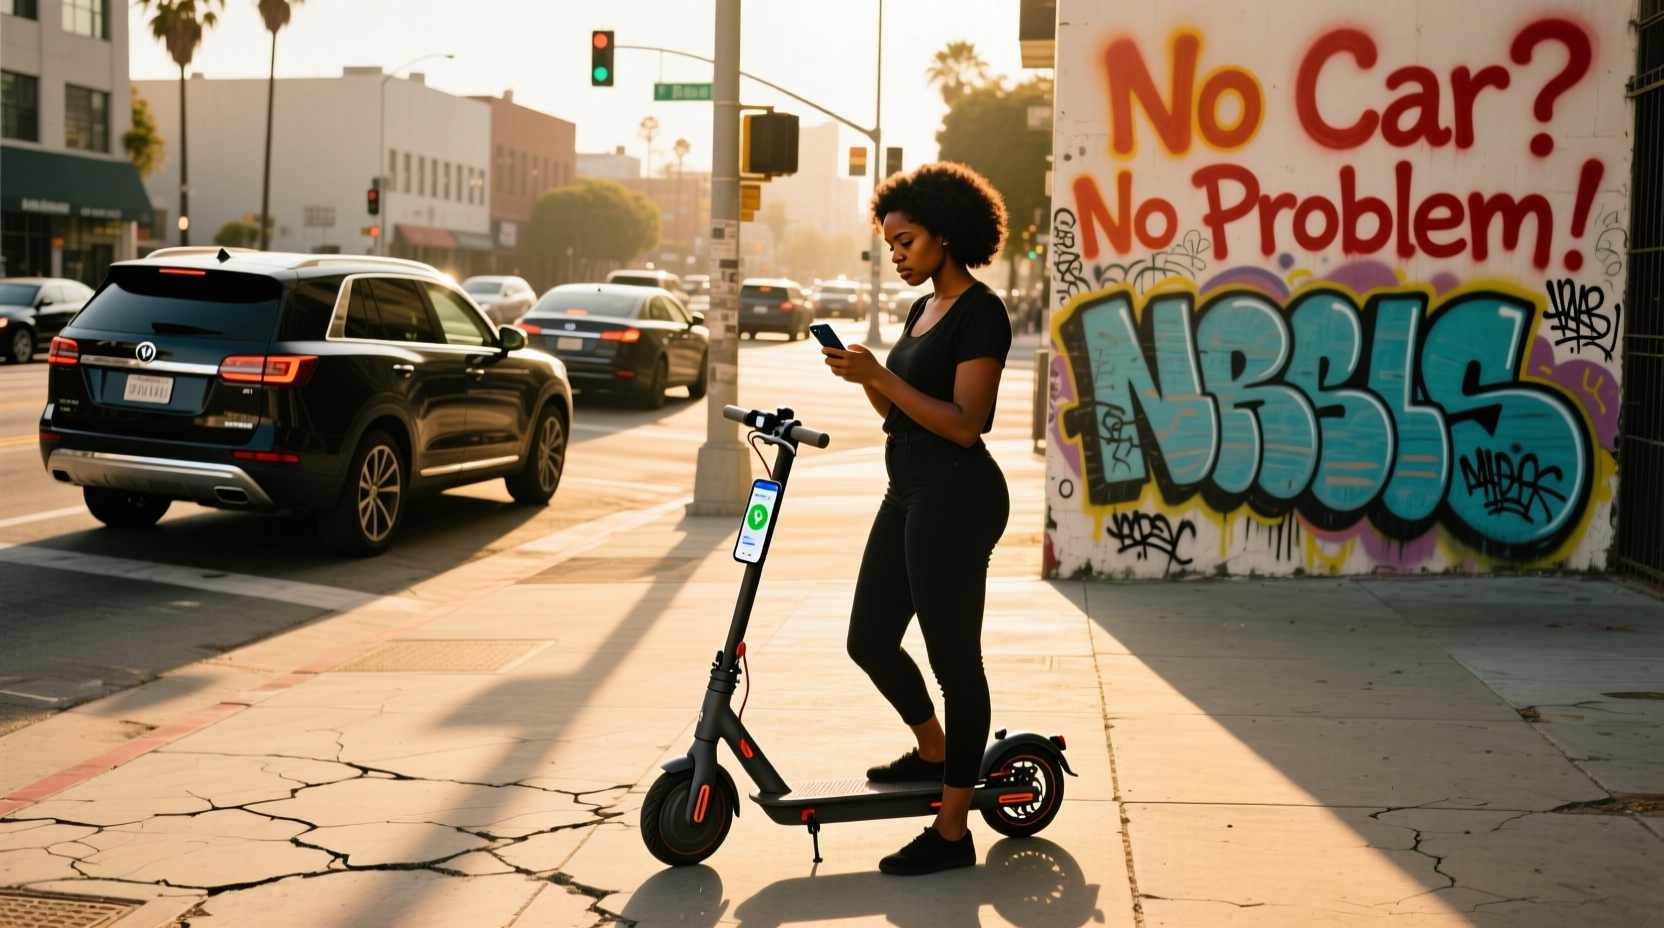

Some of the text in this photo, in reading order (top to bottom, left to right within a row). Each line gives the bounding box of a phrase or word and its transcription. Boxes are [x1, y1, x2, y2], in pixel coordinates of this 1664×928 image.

[1104, 19, 1593, 158] No Car?
[1073, 169, 1179, 260] No
[1191, 159, 1605, 272] Problem!
